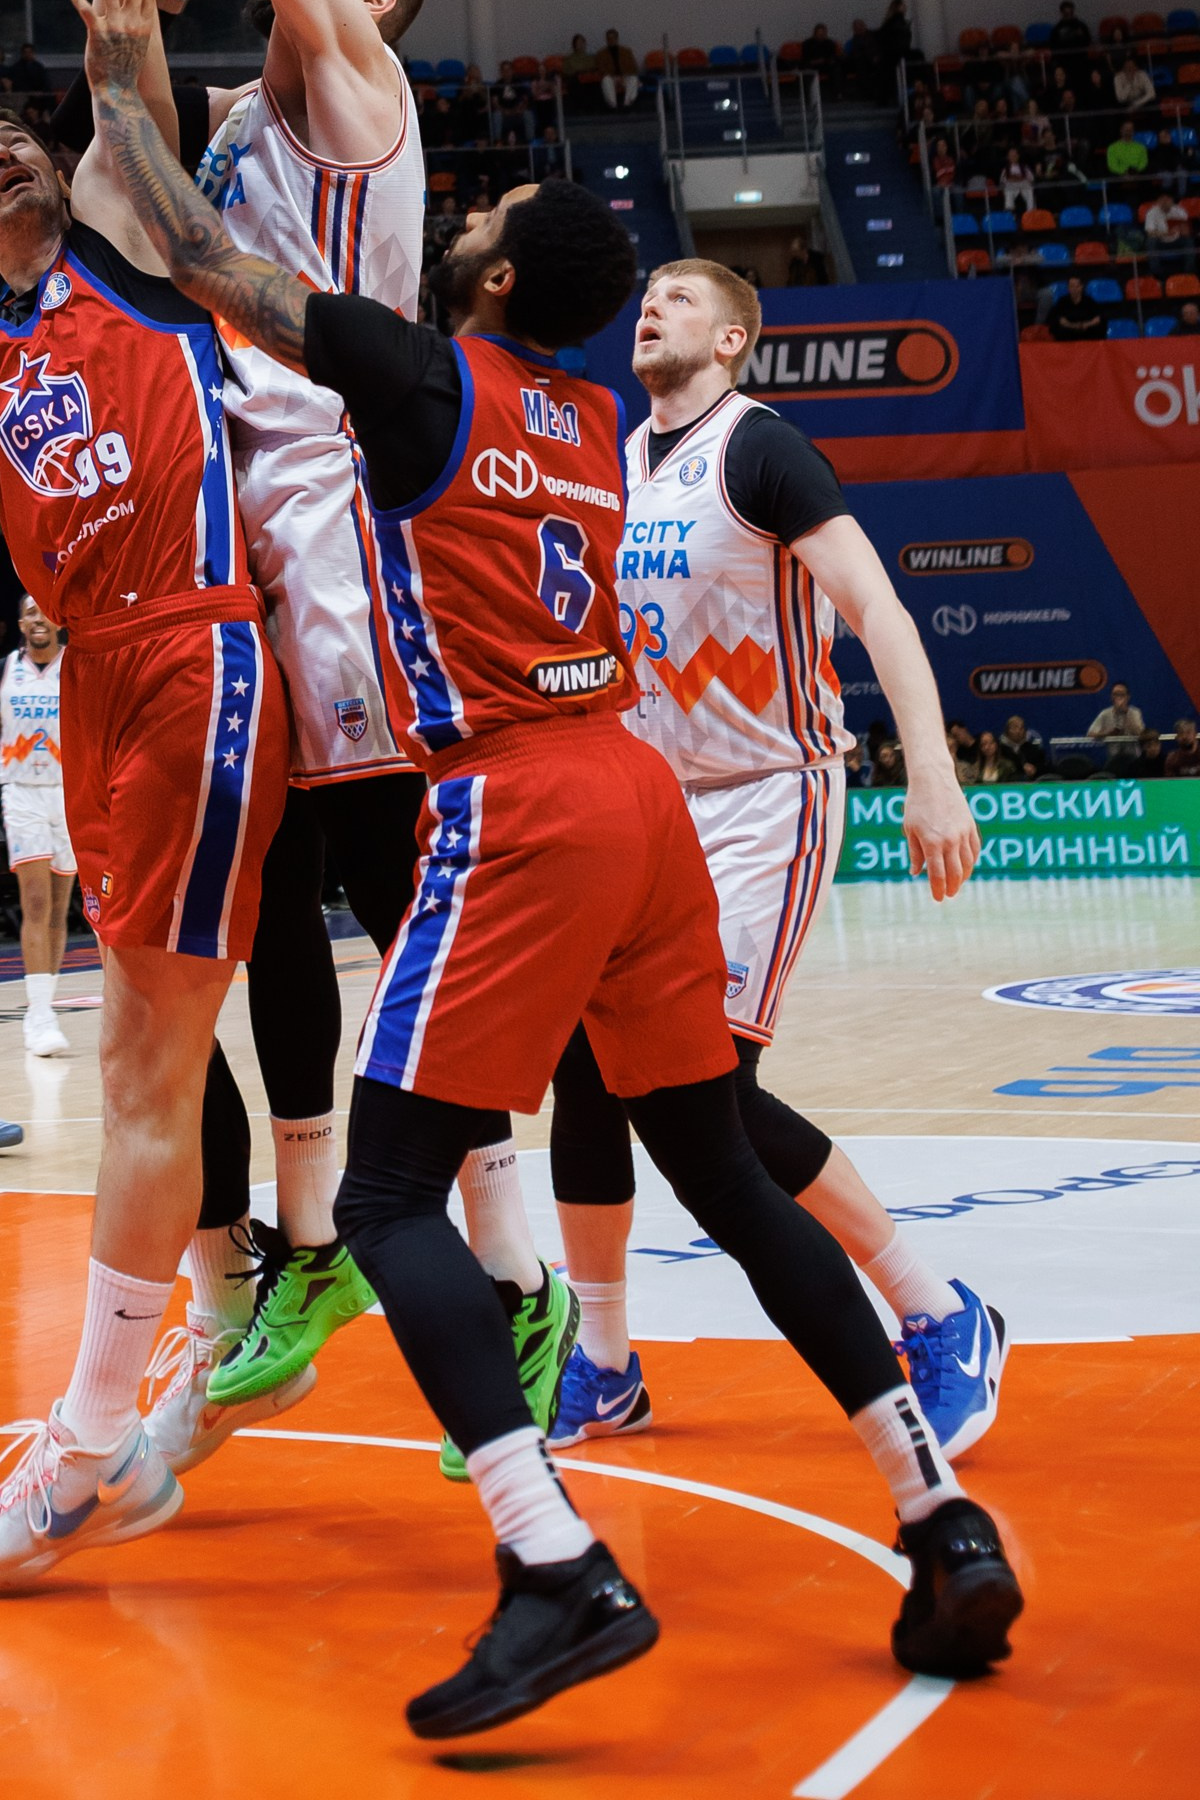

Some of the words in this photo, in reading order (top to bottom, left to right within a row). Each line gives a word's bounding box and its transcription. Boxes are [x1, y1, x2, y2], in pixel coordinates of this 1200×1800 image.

[738, 338, 888, 386] NLINE
[10, 393, 81, 451] CSKA
[519, 387, 582, 448] MELO
[73, 430, 133, 500] 99
[620, 520, 698, 545] TCITY
[536, 513, 596, 635] 6
[909, 544, 1005, 570] WINLINE
[979, 667, 1077, 693] WINLINE
[32, 727, 49, 751] 2
[851, 780, 1146, 826] МООВСКИЙ
[853, 826, 1190, 872] ЭНКРИННЫЙ
